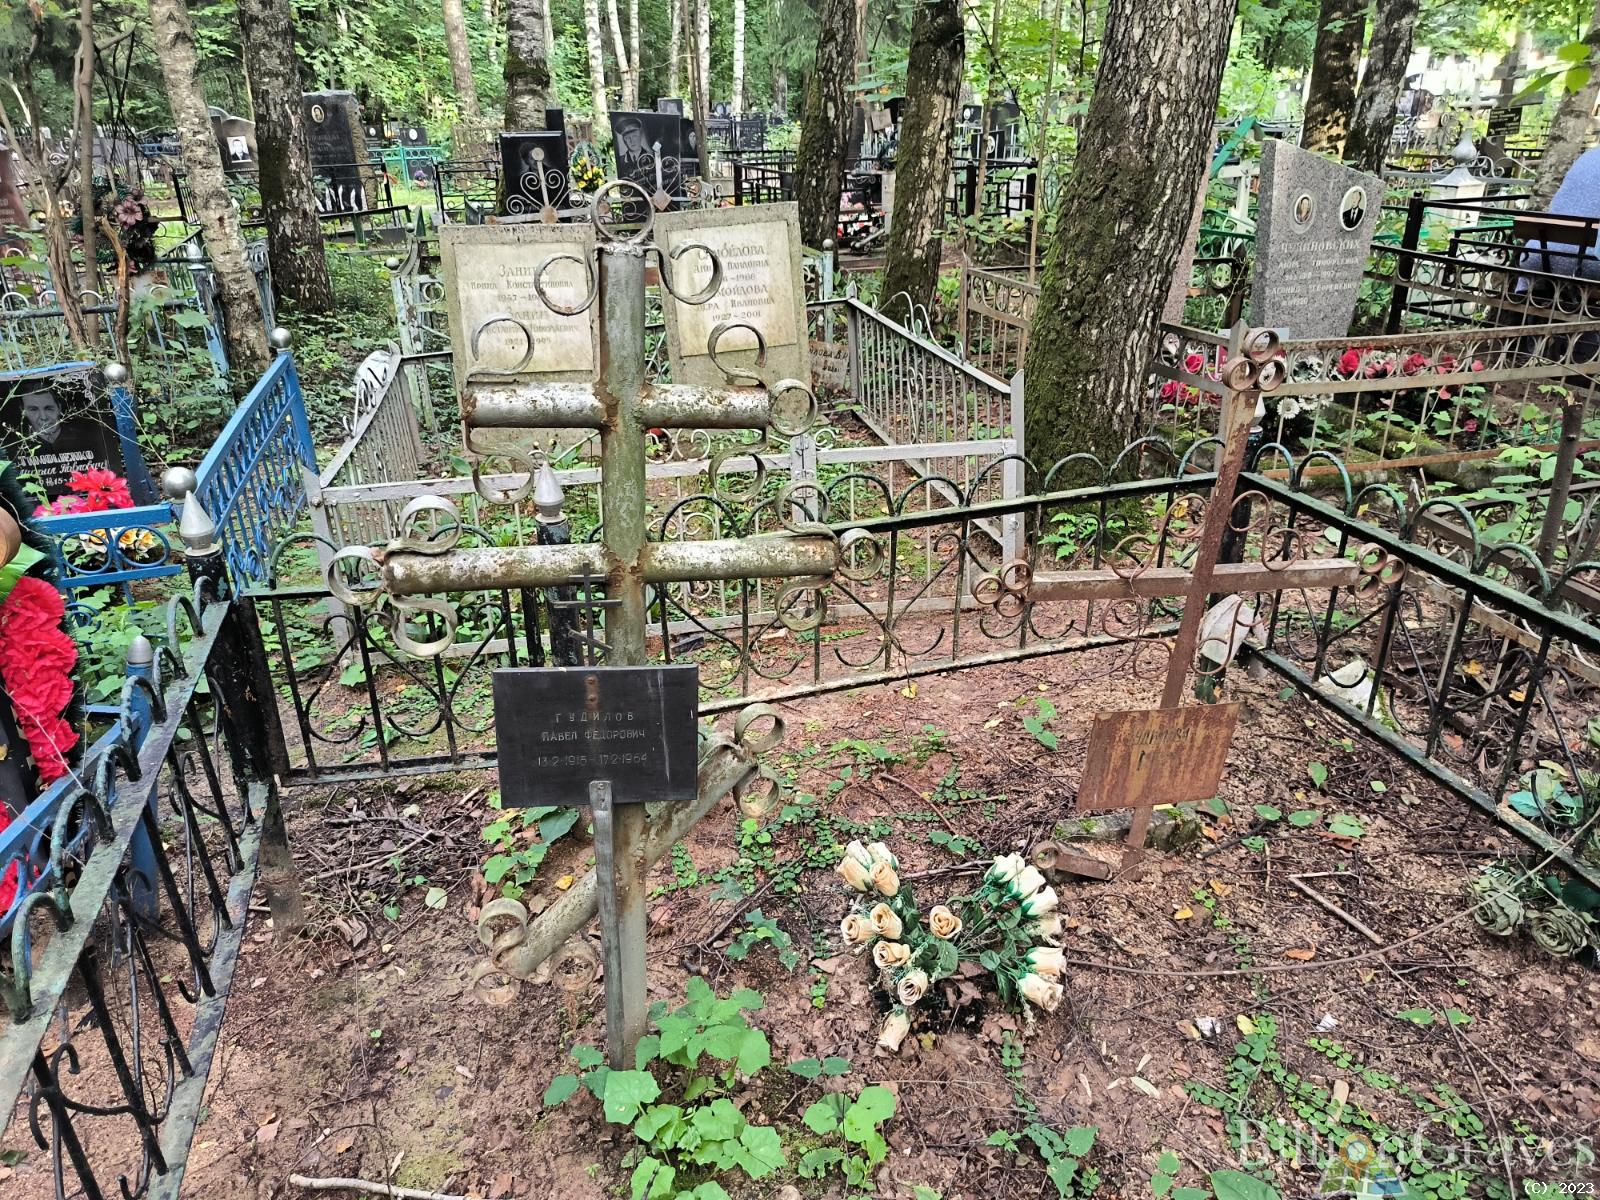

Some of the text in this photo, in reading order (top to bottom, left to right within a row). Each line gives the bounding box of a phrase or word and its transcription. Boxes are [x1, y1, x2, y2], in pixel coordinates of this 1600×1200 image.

[698, 243, 764, 260] СМОЙЛОВА
[555, 711, 634, 723] ГУДИЛОВ
[541, 729, 646, 742] ПАВЕЛ ФЕДОРОВИЧ
